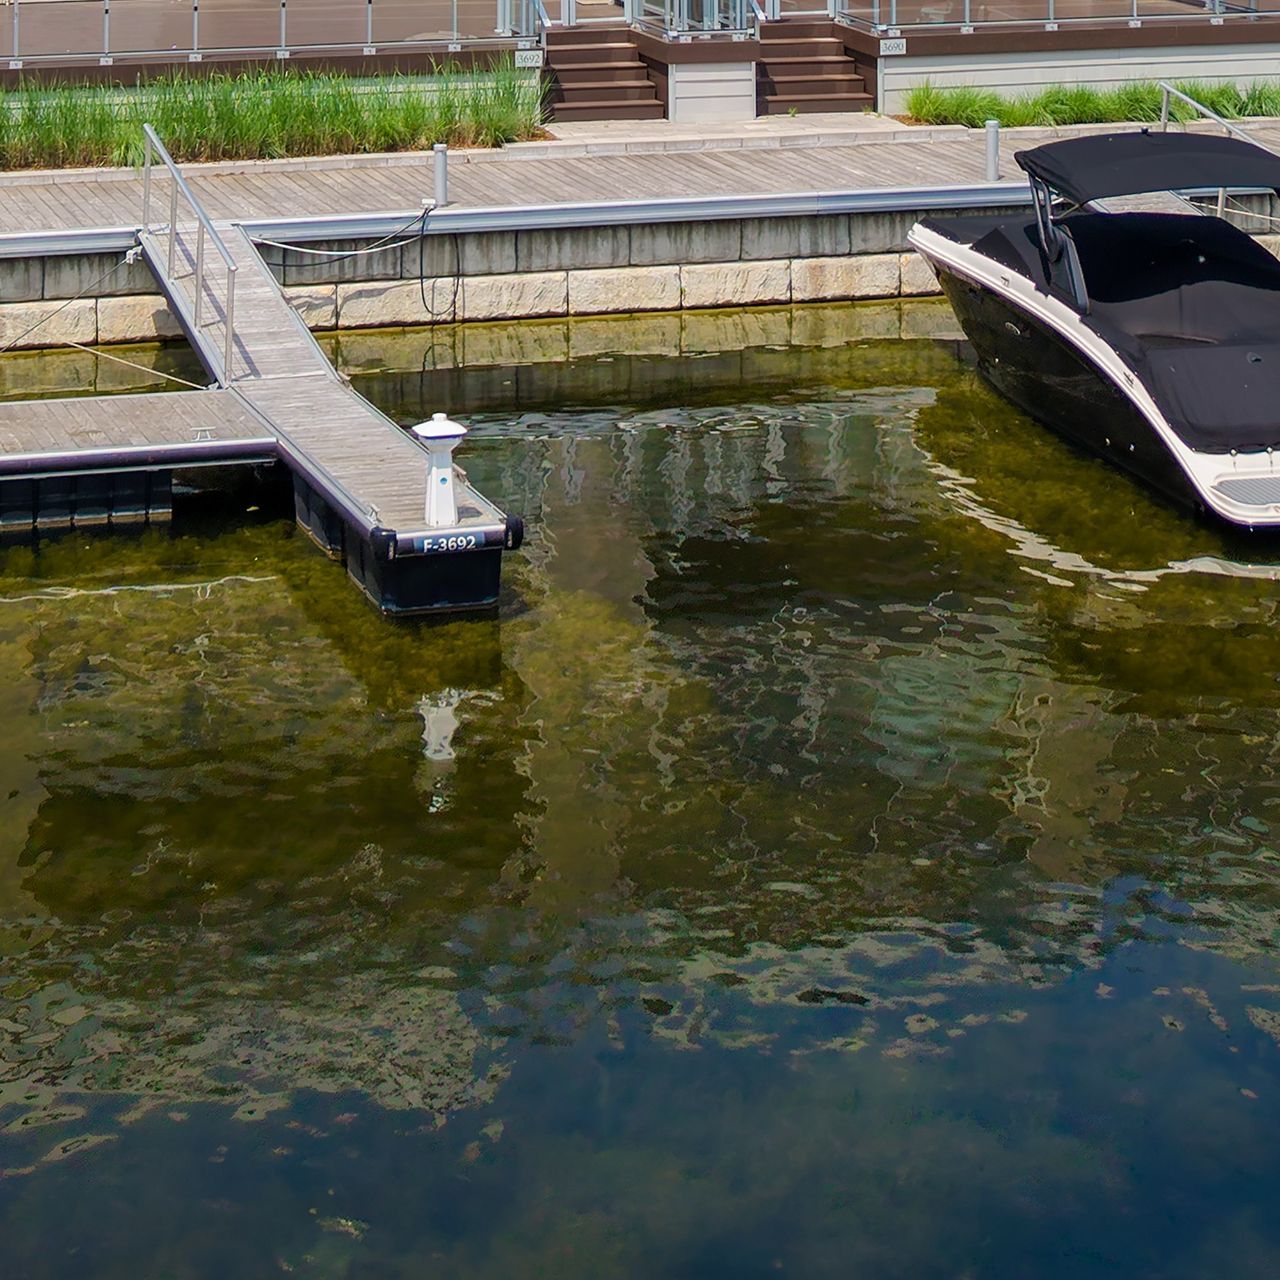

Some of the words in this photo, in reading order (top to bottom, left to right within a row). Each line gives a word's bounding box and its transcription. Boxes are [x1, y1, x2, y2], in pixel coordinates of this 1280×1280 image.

[881, 41, 904, 52] 3690
[516, 53, 540, 64] 3692
[423, 535, 476, 553] F-3692
